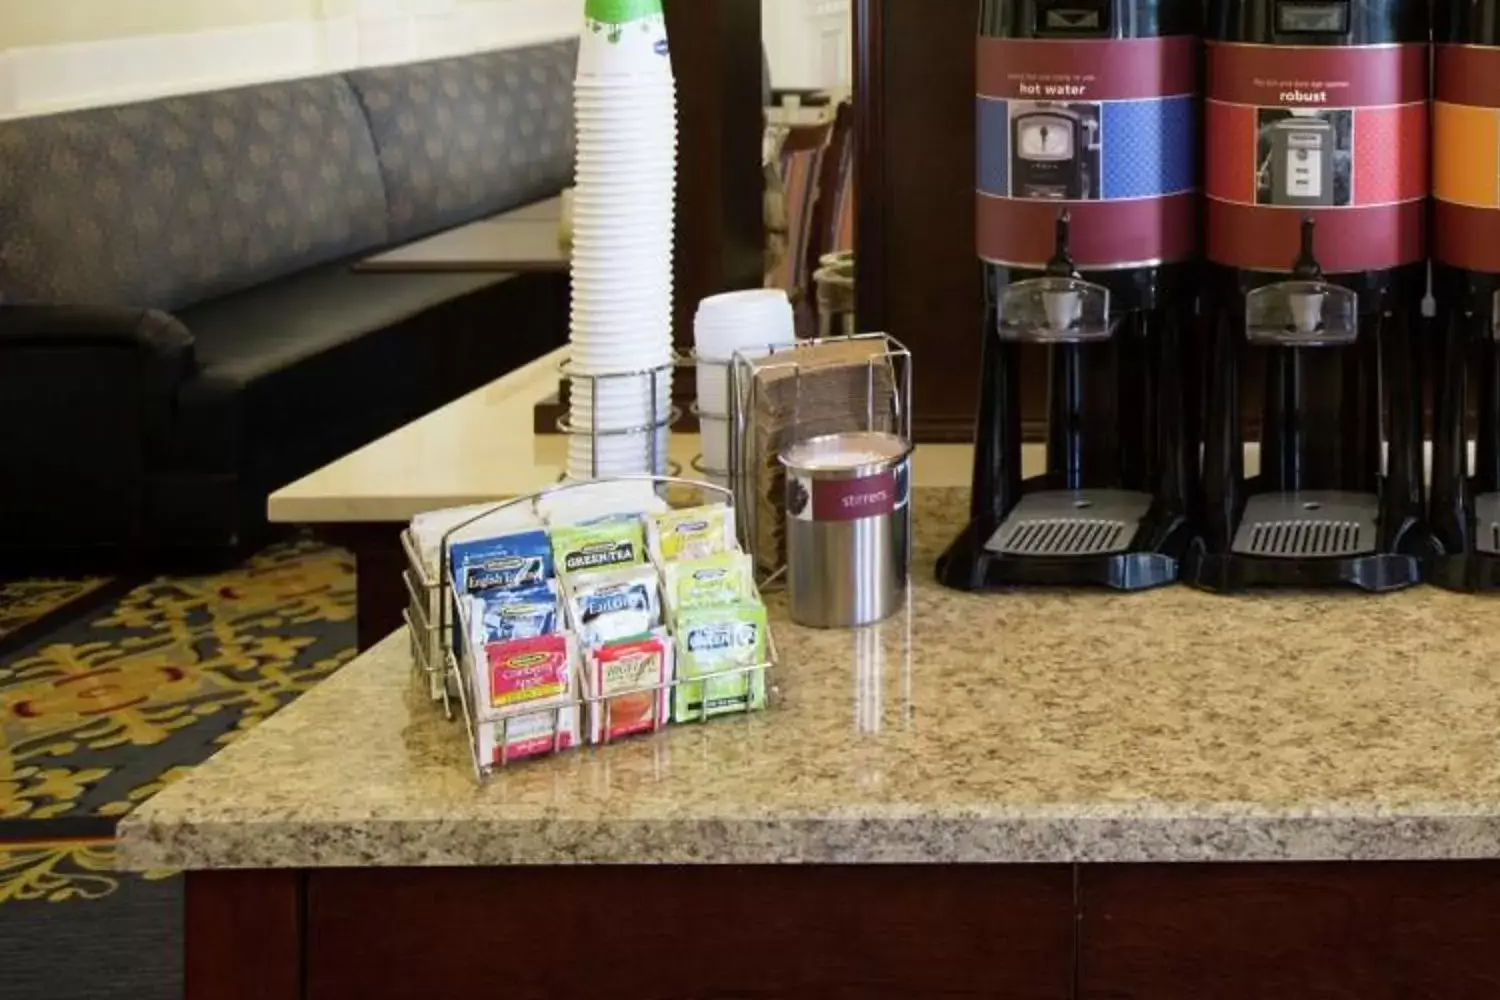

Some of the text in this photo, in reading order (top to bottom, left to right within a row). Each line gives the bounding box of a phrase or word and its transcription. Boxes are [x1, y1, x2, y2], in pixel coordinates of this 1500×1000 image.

[1019, 81, 1087, 96] hot water
[1279, 89, 1327, 103] robust
[840, 489, 888, 508] stirrers
[567, 549, 633, 569] GREEN TEA
